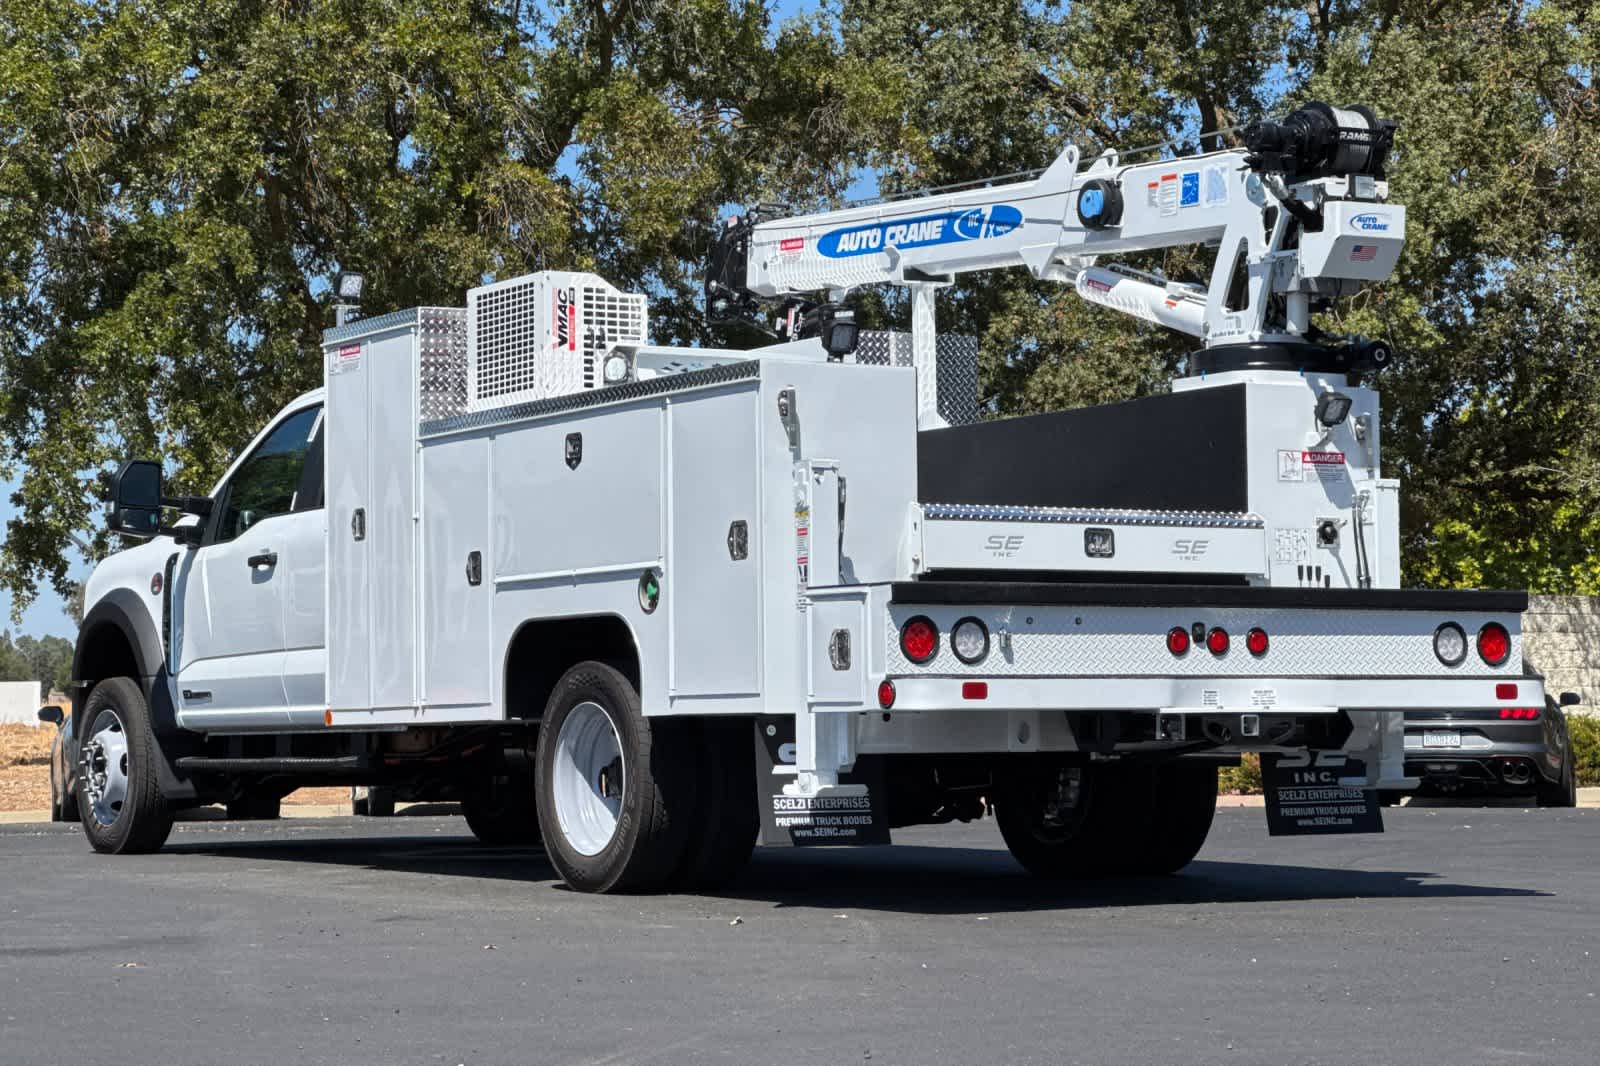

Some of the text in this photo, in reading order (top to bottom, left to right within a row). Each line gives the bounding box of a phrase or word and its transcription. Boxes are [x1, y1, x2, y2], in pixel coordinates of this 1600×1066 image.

[1357, 216, 1377, 224] AUTO
[1361, 223, 1389, 231] CRANE
[836, 219, 945, 253] AUTO CRANE
[557, 288, 568, 347] VMAC
[1311, 454, 1343, 463] DANGER
[984, 535, 1025, 550] SE
[1171, 540, 1208, 554] SE
[1294, 771, 1336, 784] INC.
[1278, 787, 1364, 801] SCELZI ENTERPRISES
[773, 797, 871, 810] SCELZI ENTERPRISES
[1280, 806, 1315, 817] PREMIUM
[775, 815, 873, 827] PREMIUM TRUCK BODIES
[794, 827, 857, 837] www.SEINC.com
